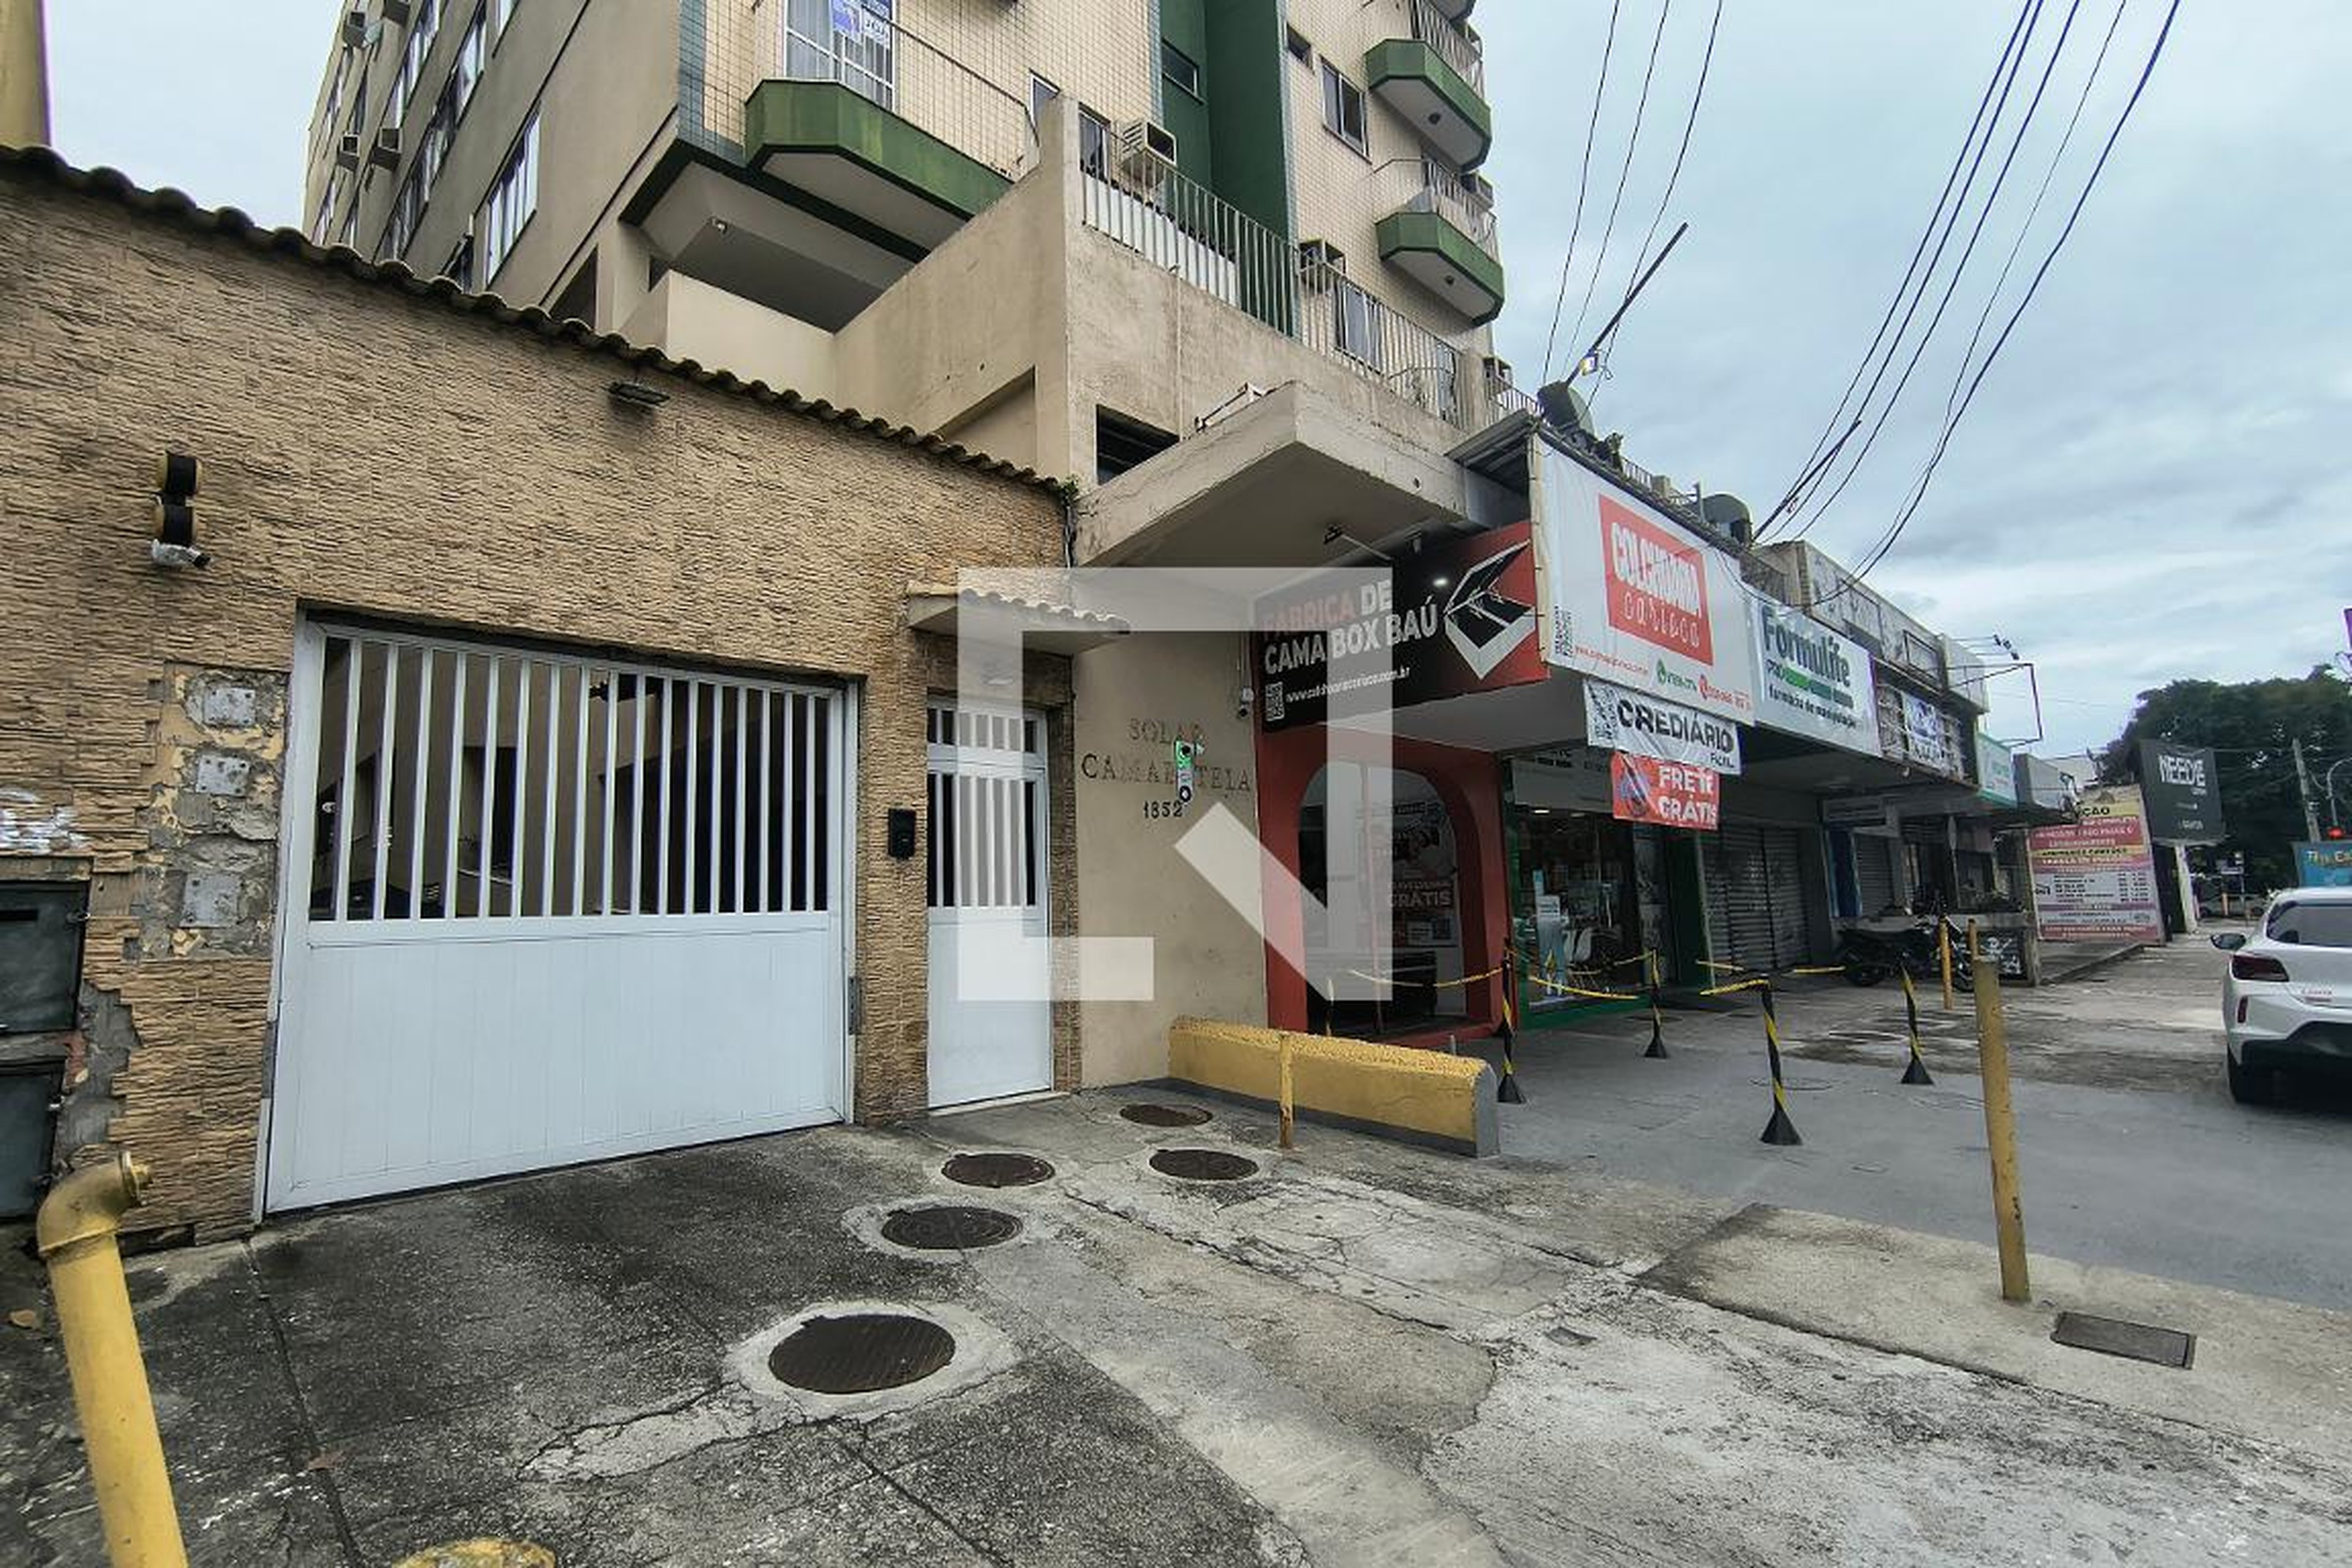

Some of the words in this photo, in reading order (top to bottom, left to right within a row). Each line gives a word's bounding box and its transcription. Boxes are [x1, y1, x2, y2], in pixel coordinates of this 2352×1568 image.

[1361, 579, 1393, 616] DE
[1265, 633, 1327, 674] CAMA
[1330, 618, 1381, 660] BOX
[1385, 594, 1437, 647] BAÚ
[1762, 605, 1850, 688] Formulife
[1617, 699, 1735, 753] CREDIÁRIO
[1144, 801, 1183, 819] 1852
